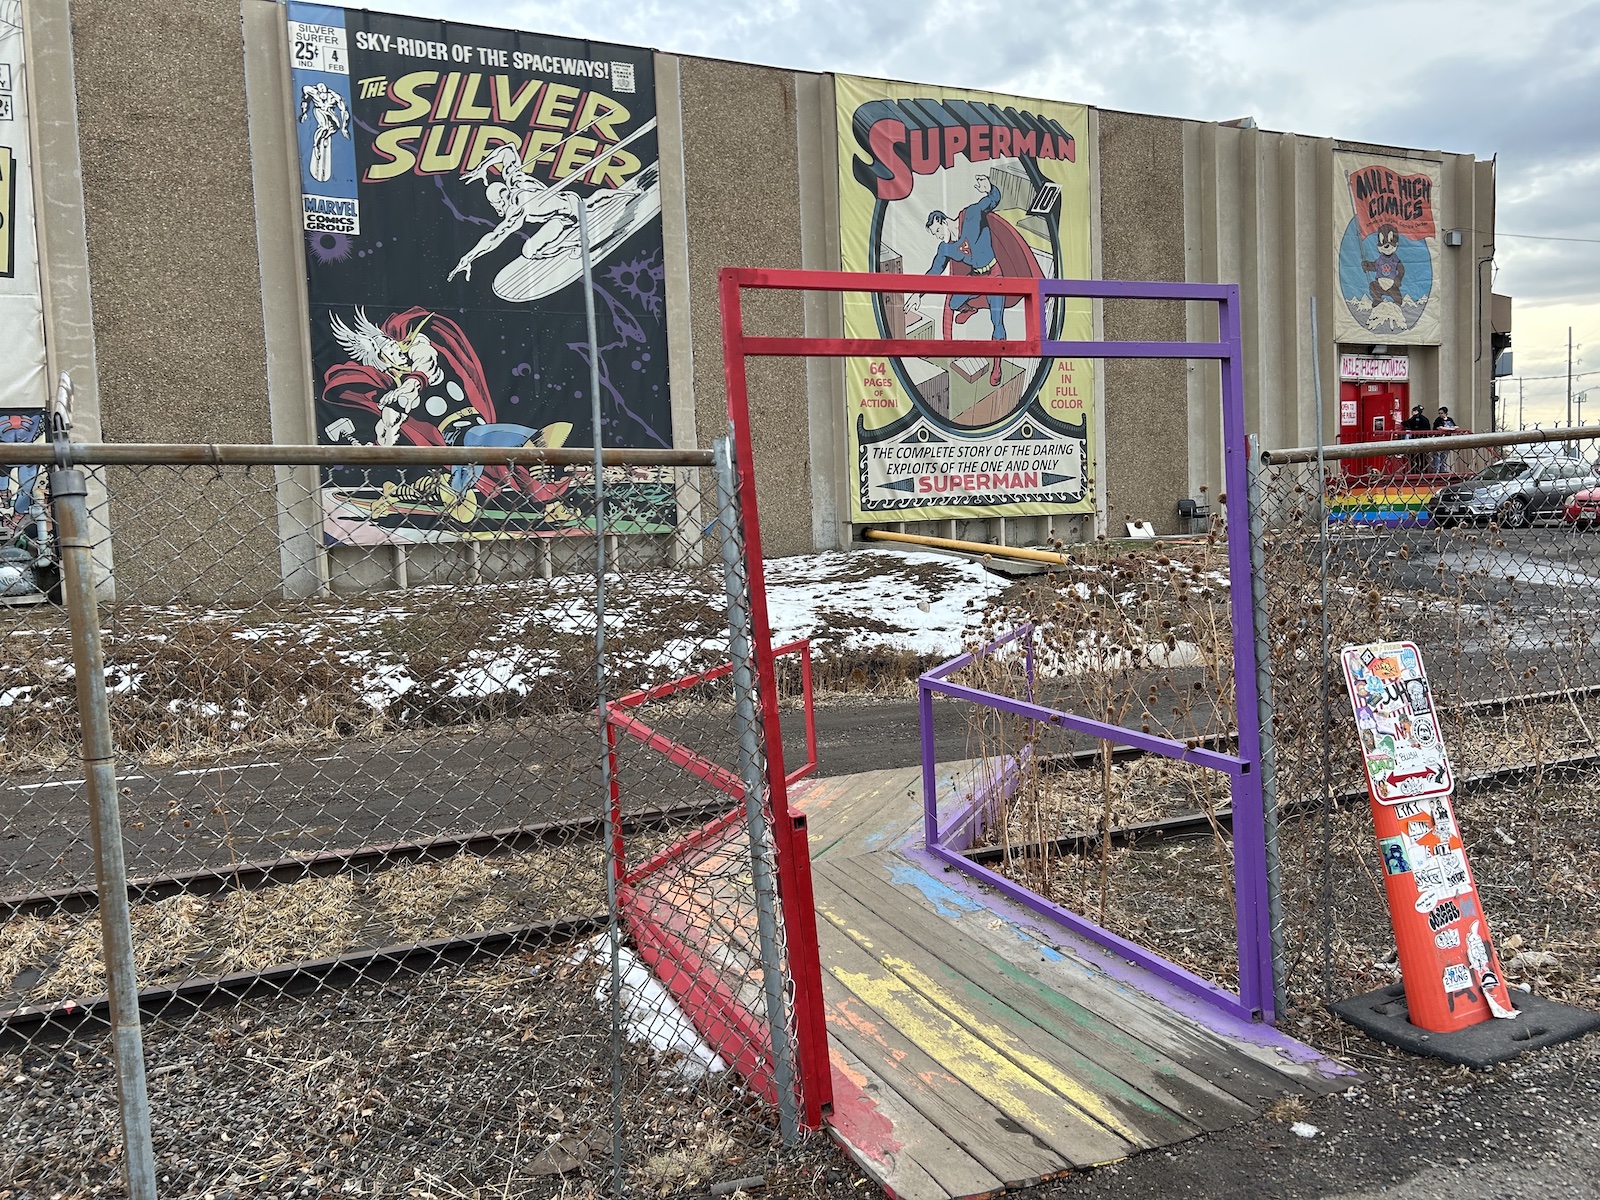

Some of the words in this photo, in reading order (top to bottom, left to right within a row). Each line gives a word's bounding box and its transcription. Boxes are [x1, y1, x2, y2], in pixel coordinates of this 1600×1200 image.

[298, 24, 335, 36] SILVER
[296, 32, 339, 45] SURFER
[331, 50, 339, 62] 4
[355, 31, 449, 61] SKY-RIDER
[451, 43, 473, 64] OF
[476, 47, 509, 68] THE
[512, 51, 610, 80] SPACEWAYS!
[298, 60, 315, 68] IND.
[328, 63, 345, 72] FEB
[357, 76, 388, 100] THE
[380, 70, 632, 142] SILVER
[364, 124, 643, 189] SURFER
[866, 116, 1076, 201] SUPERMAN
[1356, 168, 1395, 201] MILE
[1397, 175, 1431, 204] HIGH
[304, 197, 358, 217] MARVEL
[1369, 195, 1423, 221] COMICS
[306, 214, 355, 226] COMICS
[306, 222, 355, 233] GROUP
[869, 362, 886, 375] 64
[1058, 361, 1075, 371] ALL
[1342, 357, 1359, 376] MILE
[1361, 358, 1379, 376] HIGH
[1380, 359, 1407, 377] COMICS
[863, 377, 893, 387] PAGES
[1061, 374, 1072, 384] IN
[874, 389, 884, 397] OF
[1055, 386, 1078, 397] FULL
[1050, 398, 1083, 409] COLOR
[873, 447, 894, 459] THE
[896, 446, 955, 459] COMPLETE
[957, 445, 992, 458] STORY
[994, 445, 1009, 457] OF
[1011, 444, 1031, 456] THE
[1033, 443, 1074, 456] DARING
[886, 462, 938, 475] EXPLOITS
[940, 462, 955, 474] OF
[958, 461, 979, 473] THE
[980, 460, 1003, 473] ONE
[1004, 460, 1030, 472] AND
[1031, 459, 1059, 471] ONLY
[918, 471, 1038, 494] SUPERMAN
